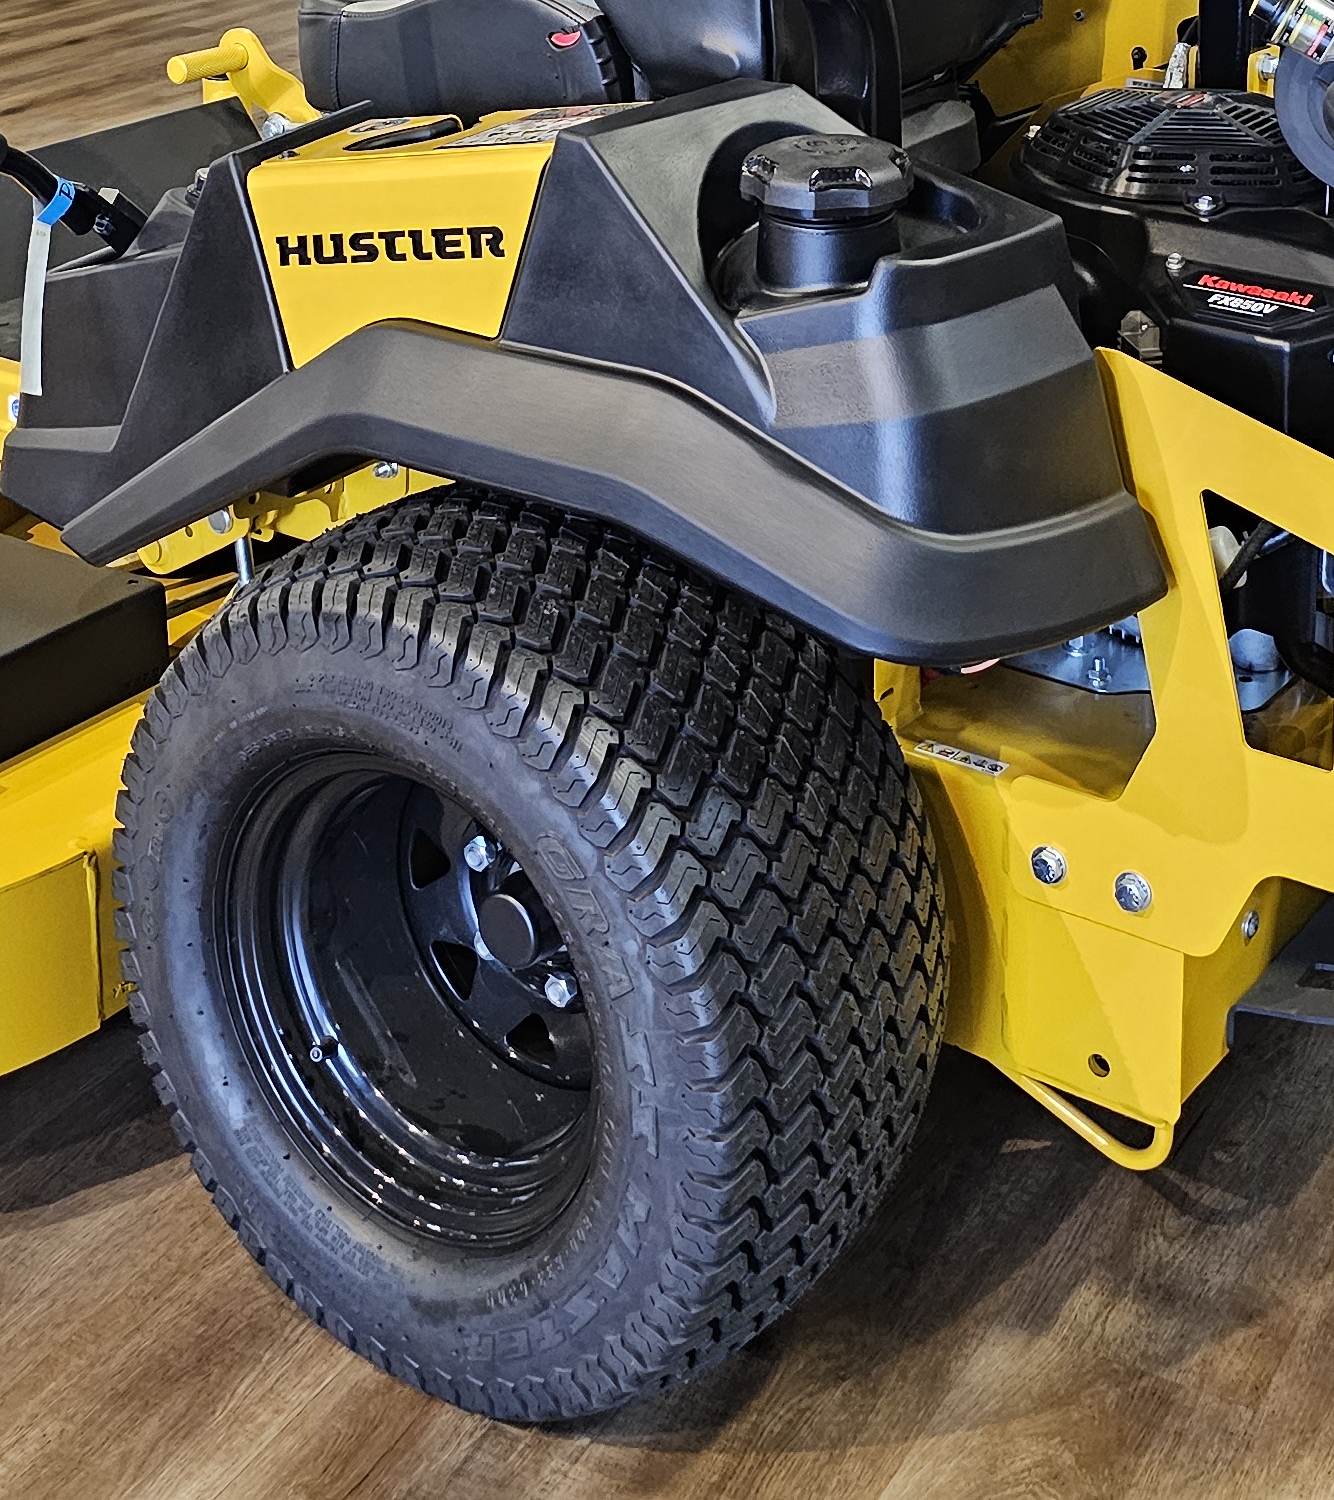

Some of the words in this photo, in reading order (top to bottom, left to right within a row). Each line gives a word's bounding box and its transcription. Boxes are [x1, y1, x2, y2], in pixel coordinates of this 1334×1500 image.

[275, 226, 506, 267] HUSTLER
[1197, 274, 1314, 306] Kawasaki
[1207, 293, 1280, 315] FX850V
